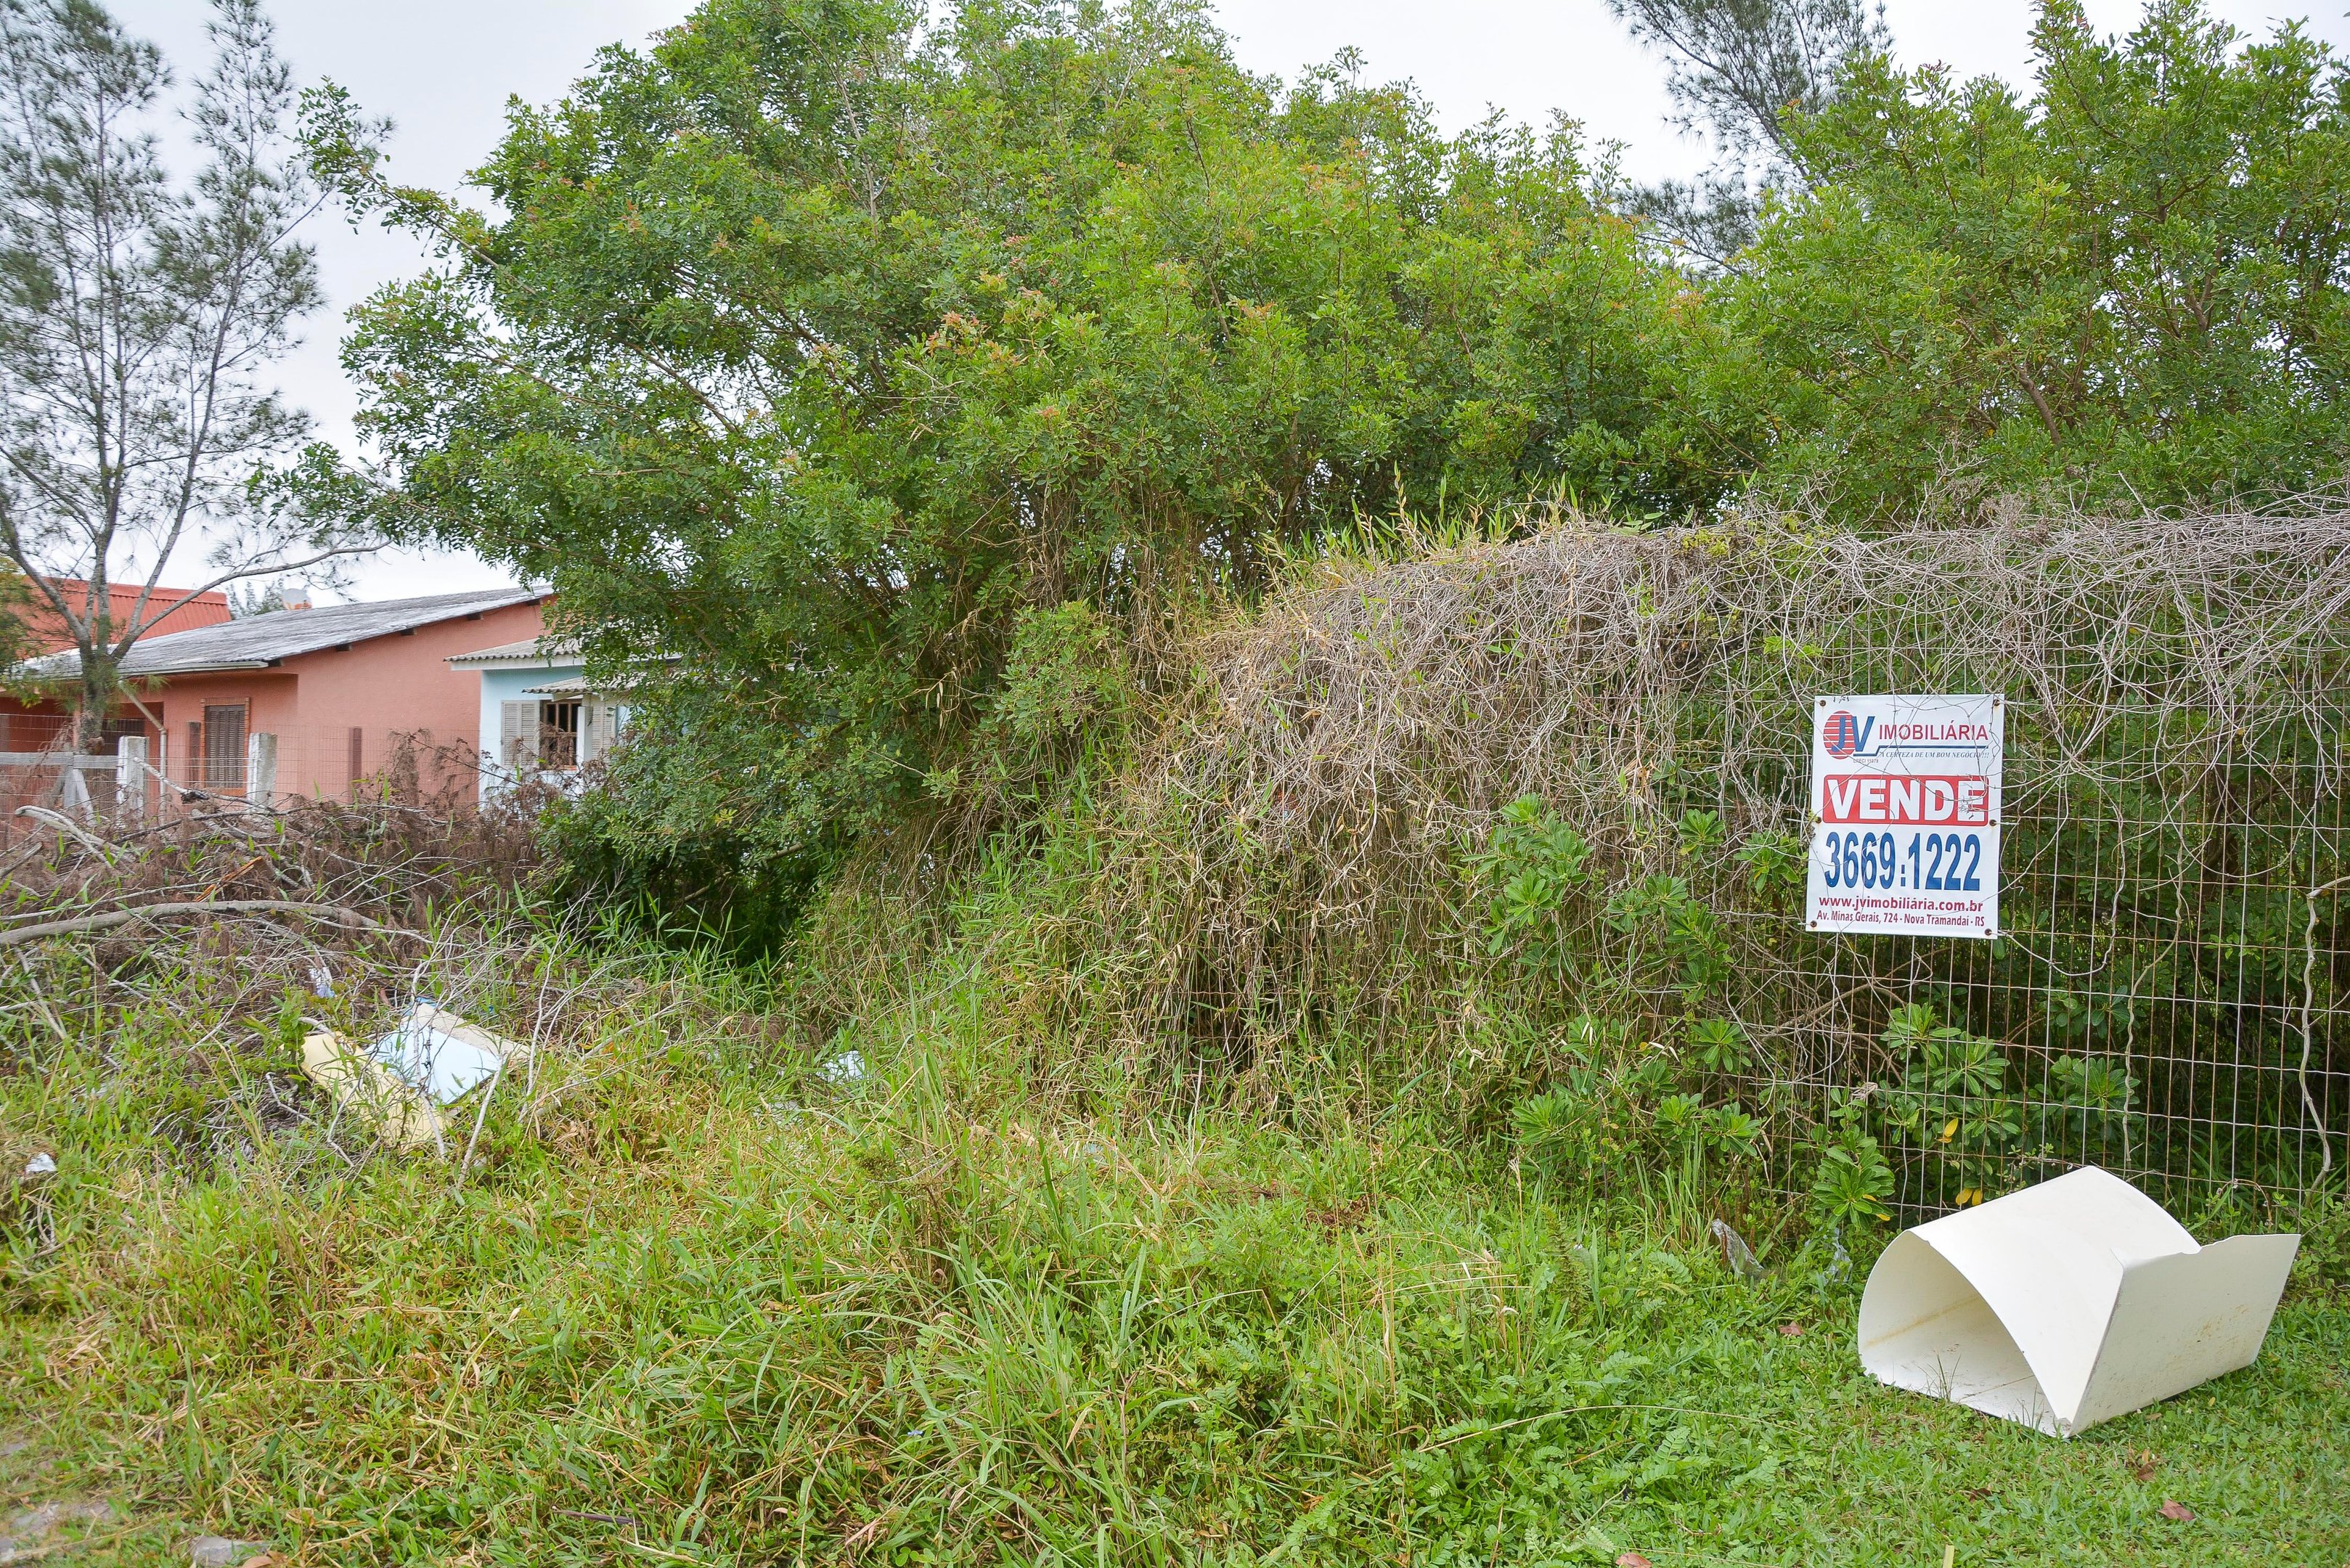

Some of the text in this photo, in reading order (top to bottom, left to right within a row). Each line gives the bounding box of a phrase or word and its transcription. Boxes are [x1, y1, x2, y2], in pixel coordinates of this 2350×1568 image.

[1831, 716, 1988, 753] JV IMOBILIÁRIA
[1827, 779, 1985, 822] VENDE
[1819, 895, 1983, 912] www.jvimobiliária.com.br
[1816, 910, 1829, 920] Av.
[1830, 910, 1853, 922] Minas
[1855, 911, 1882, 925] Gerais,
[1883, 912, 1898, 923] 724
[1904, 913, 1925, 924] Nova
[1975, 916, 1985, 926] RS
